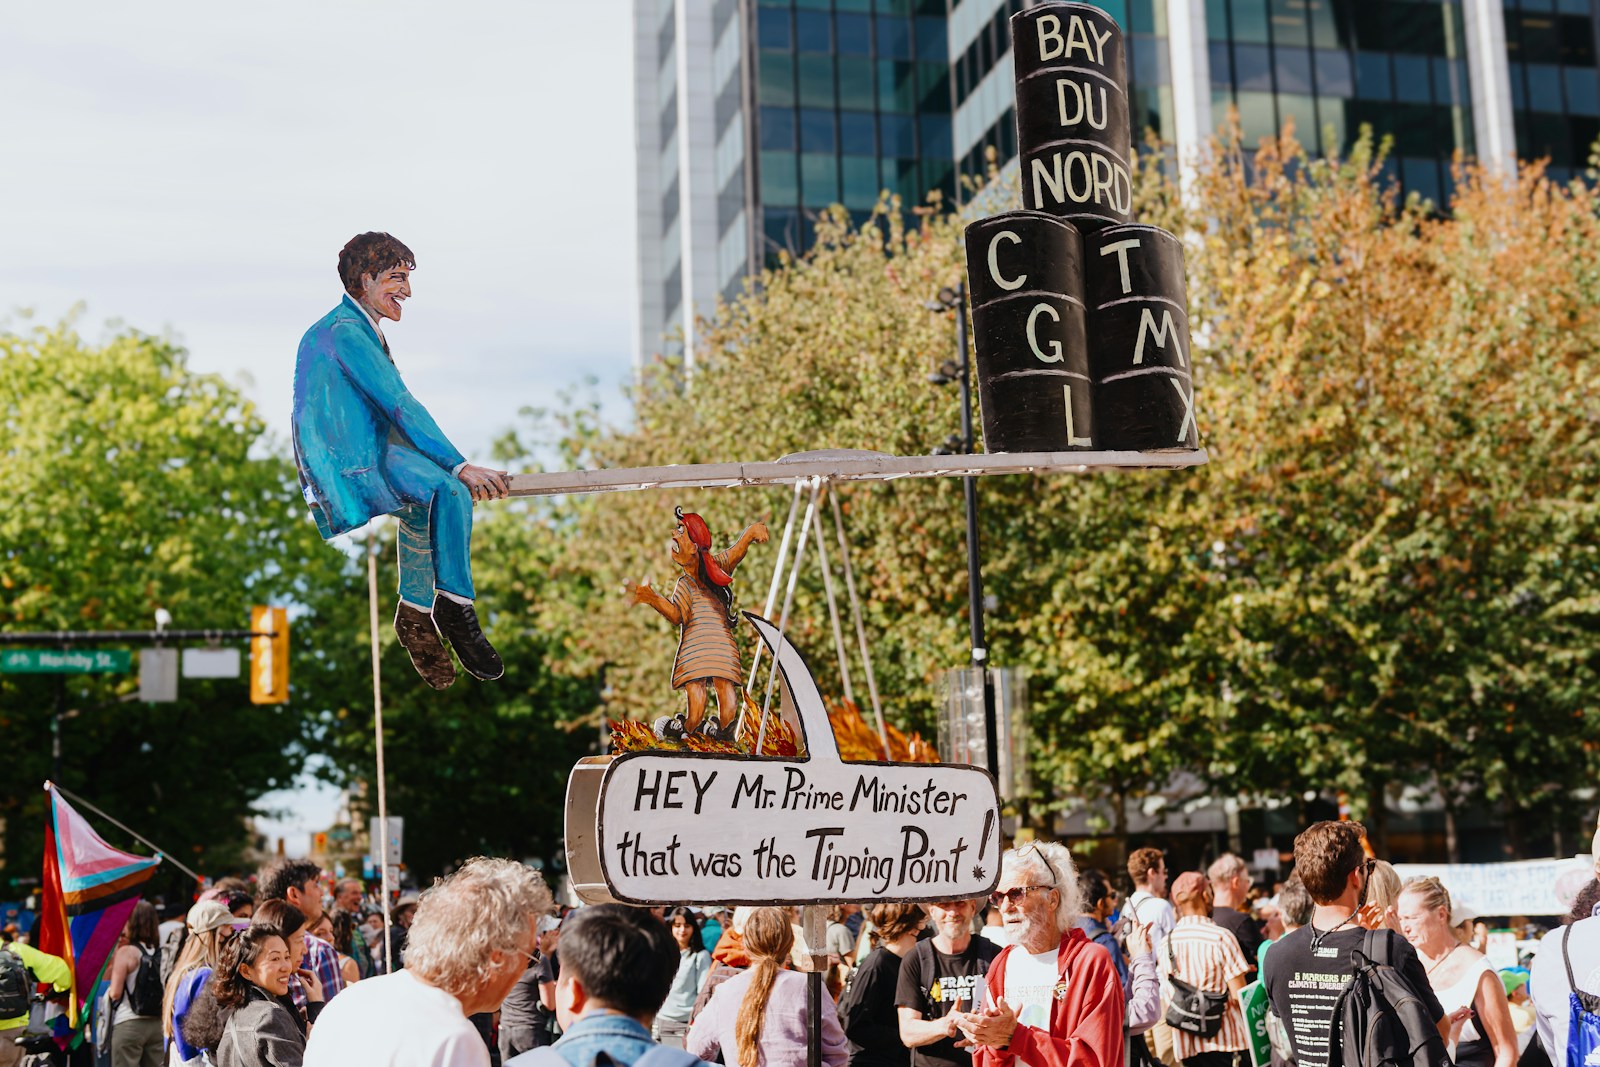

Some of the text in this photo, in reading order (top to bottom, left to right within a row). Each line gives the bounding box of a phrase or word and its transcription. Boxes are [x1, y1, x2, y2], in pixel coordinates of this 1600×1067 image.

[1036, 14, 1112, 65] BAY
[1057, 78, 1108, 131] DU
[1031, 151, 1131, 217] NORD
[38, 653, 93, 671] Hornby
[634, 767, 968, 816] HEY Mr. Prime Minister
[616, 831, 680, 877] that
[689, 851, 742, 877] was
[753, 836, 797, 878] the
[805, 827, 893, 894] Tipping
[939, 974, 983, 988] FRAC
[1288, 980, 1346, 990] CLIMATE EMERGE
[1302, 972, 1339, 982] MARKERS
[941, 988, 971, 1002] FREE
